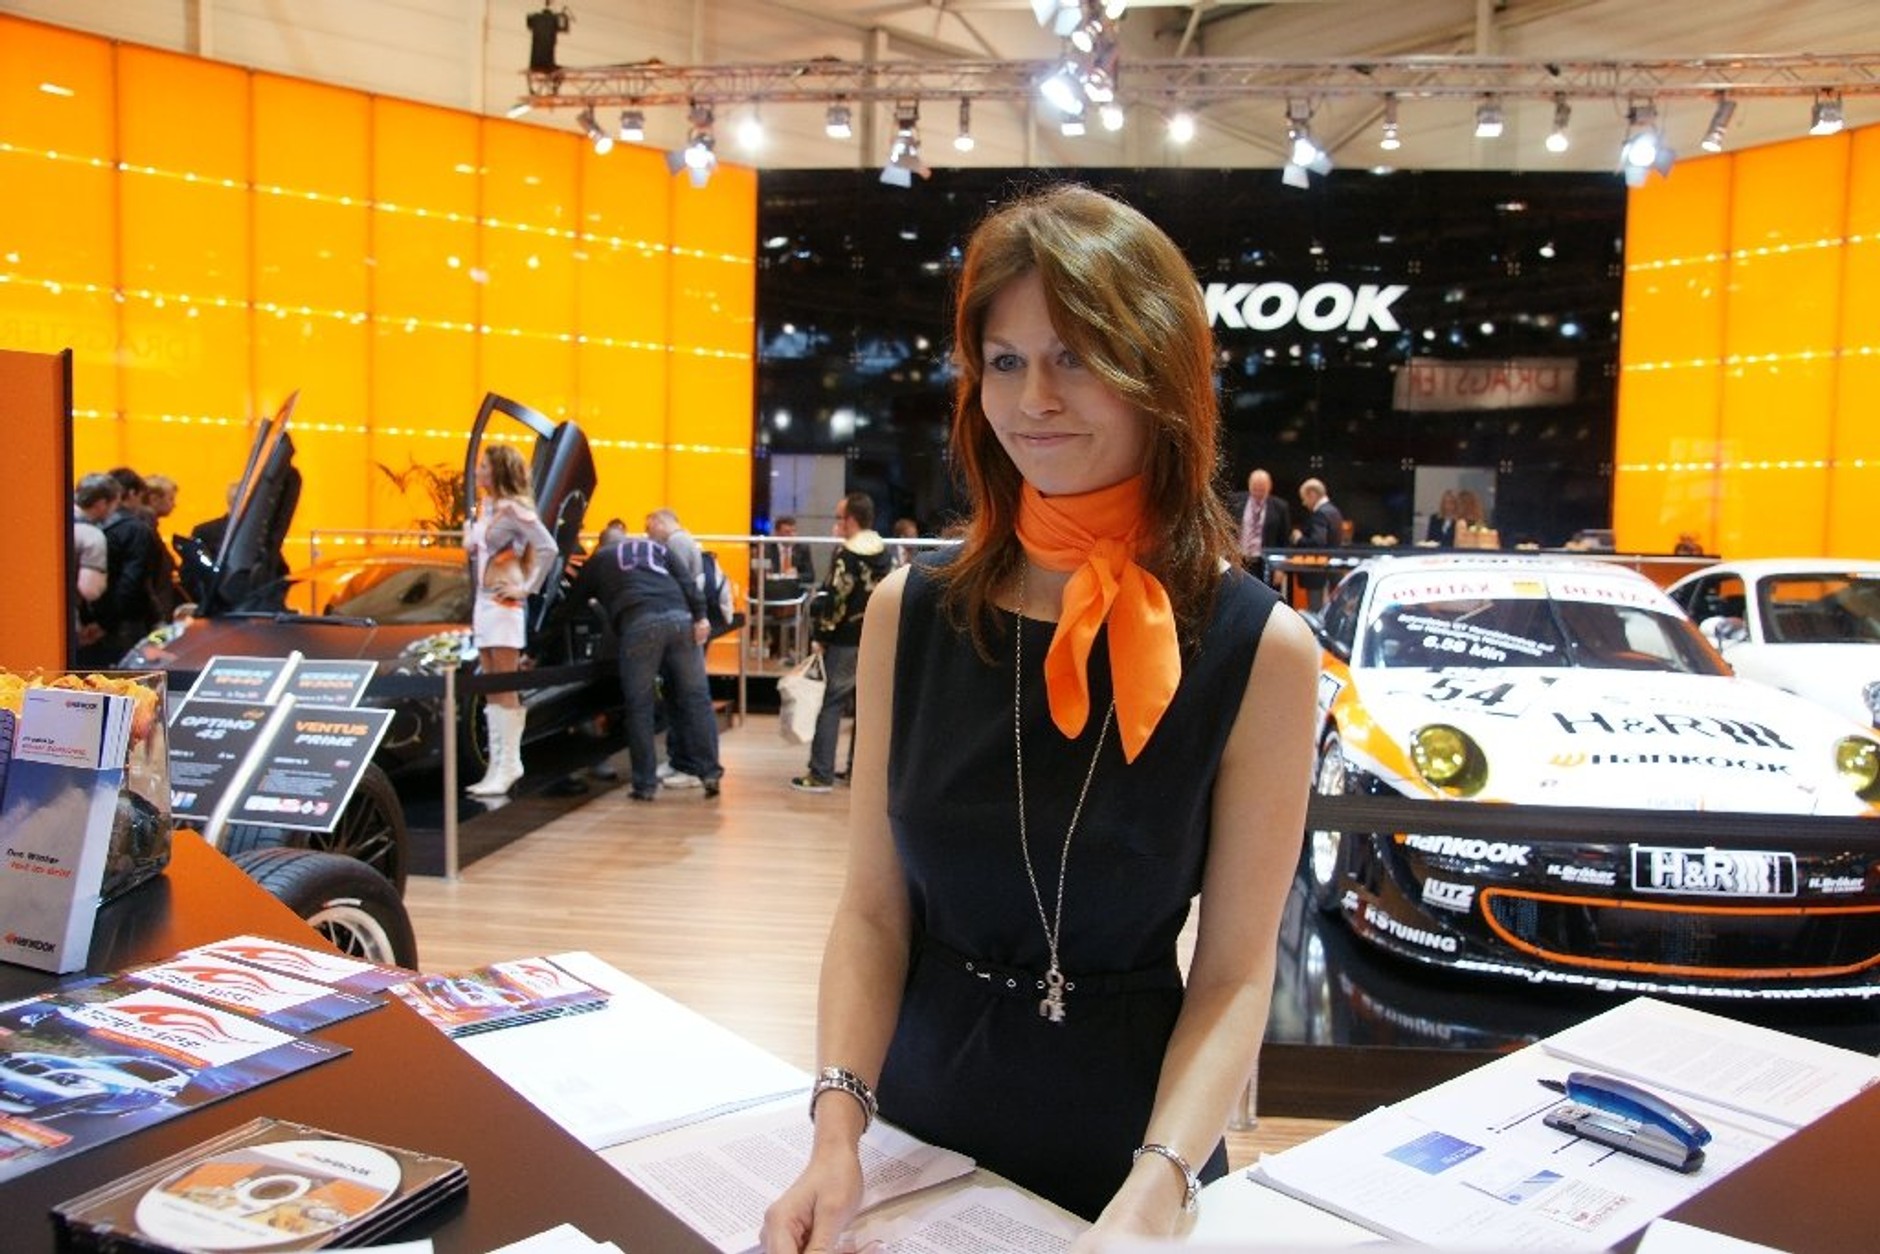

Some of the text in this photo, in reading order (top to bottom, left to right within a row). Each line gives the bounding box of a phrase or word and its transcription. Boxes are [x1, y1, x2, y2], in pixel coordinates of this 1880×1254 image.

[1422, 677, 1517, 707] 54
[180, 716, 256, 731] OPTIMO
[295, 720, 370, 737] VENTUS
[294, 734, 358, 748] PRIME
[1651, 850, 1738, 890] H&R
[1424, 878, 1475, 903] LUTZ
